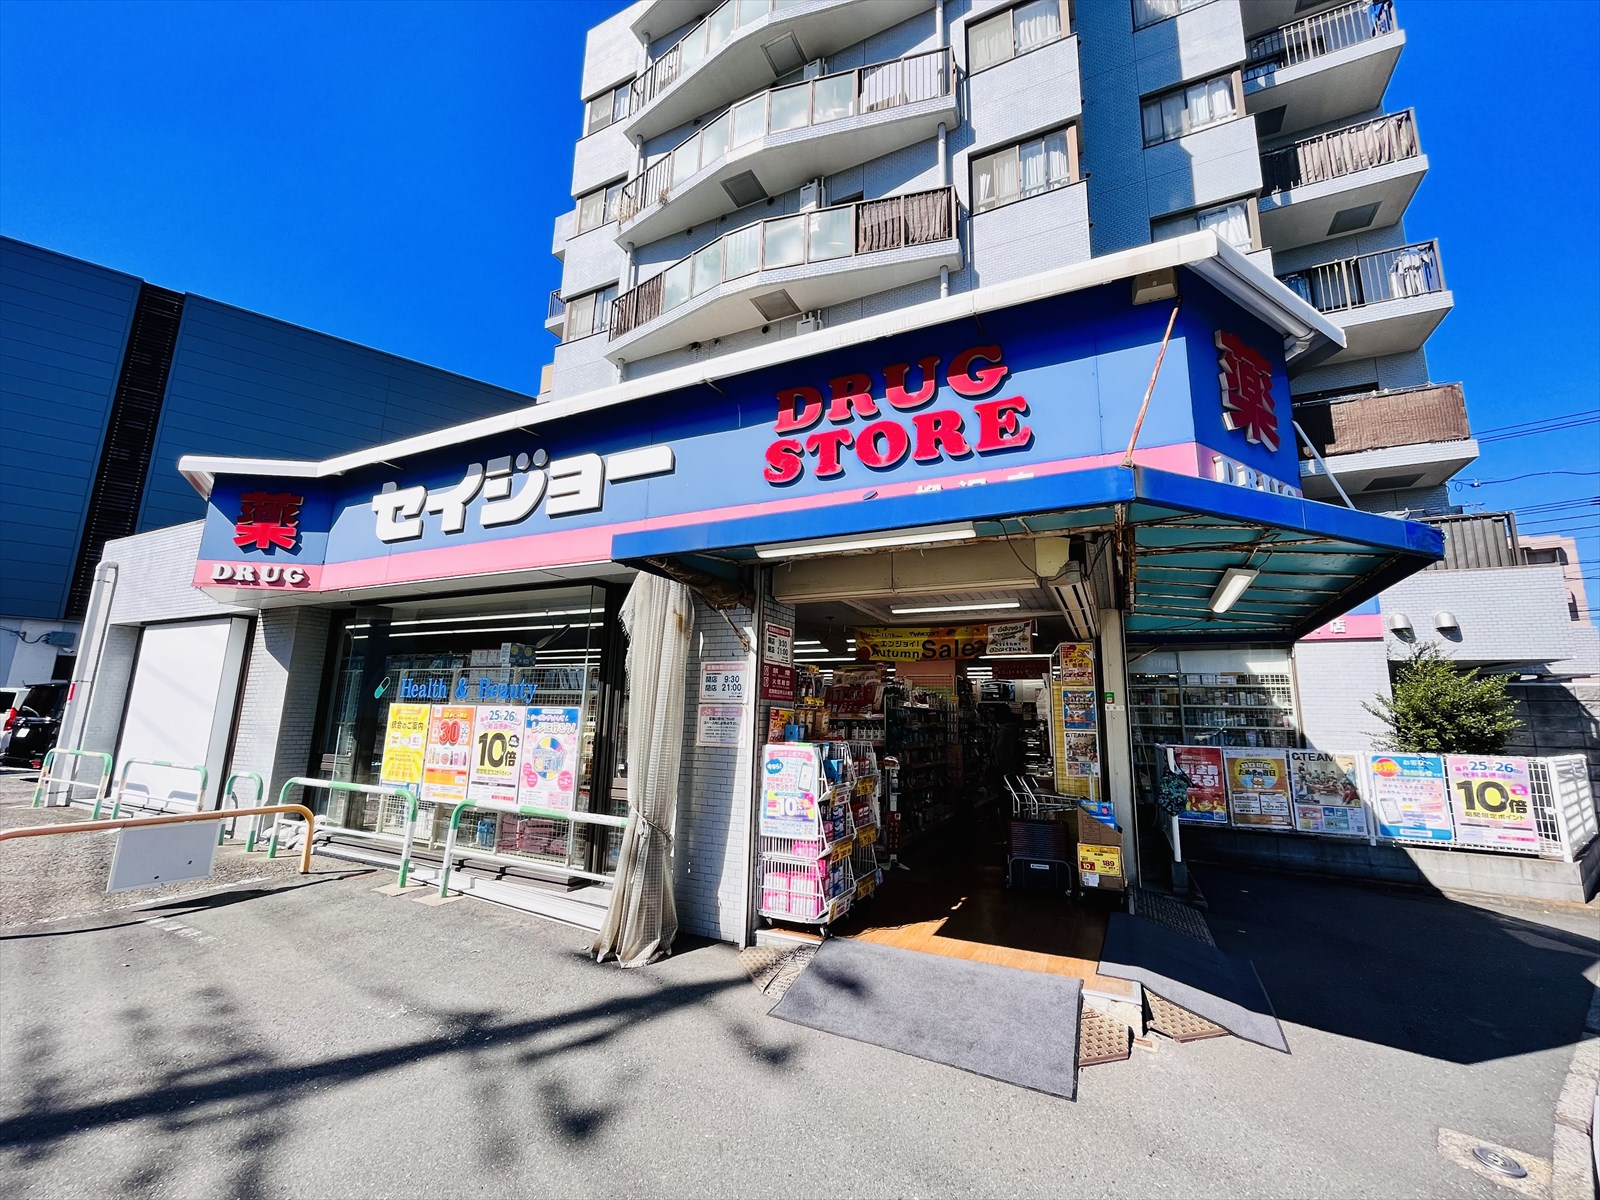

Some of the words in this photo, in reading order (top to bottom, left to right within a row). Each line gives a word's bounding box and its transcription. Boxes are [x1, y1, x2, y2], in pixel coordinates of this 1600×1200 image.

[774, 344, 1009, 434] DRUG
[1214, 329, 1280, 452] 薬
[763, 395, 1033, 483] STORE
[371, 445, 675, 543] セイジョー
[232, 491, 304, 549] 薬
[210, 563, 305, 584] DRUG
[871, 648, 920, 659] Autumn
[921, 639, 976, 659] Sale
[400, 678, 447, 698] Health
[455, 677, 469, 699] &
[477, 677, 539, 704] Beauty
[721, 683, 742, 691] 21:00
[724, 675, 740, 683] 9:30
[438, 720, 461, 743] 30
[1291, 752, 1336, 762] &TEAM
